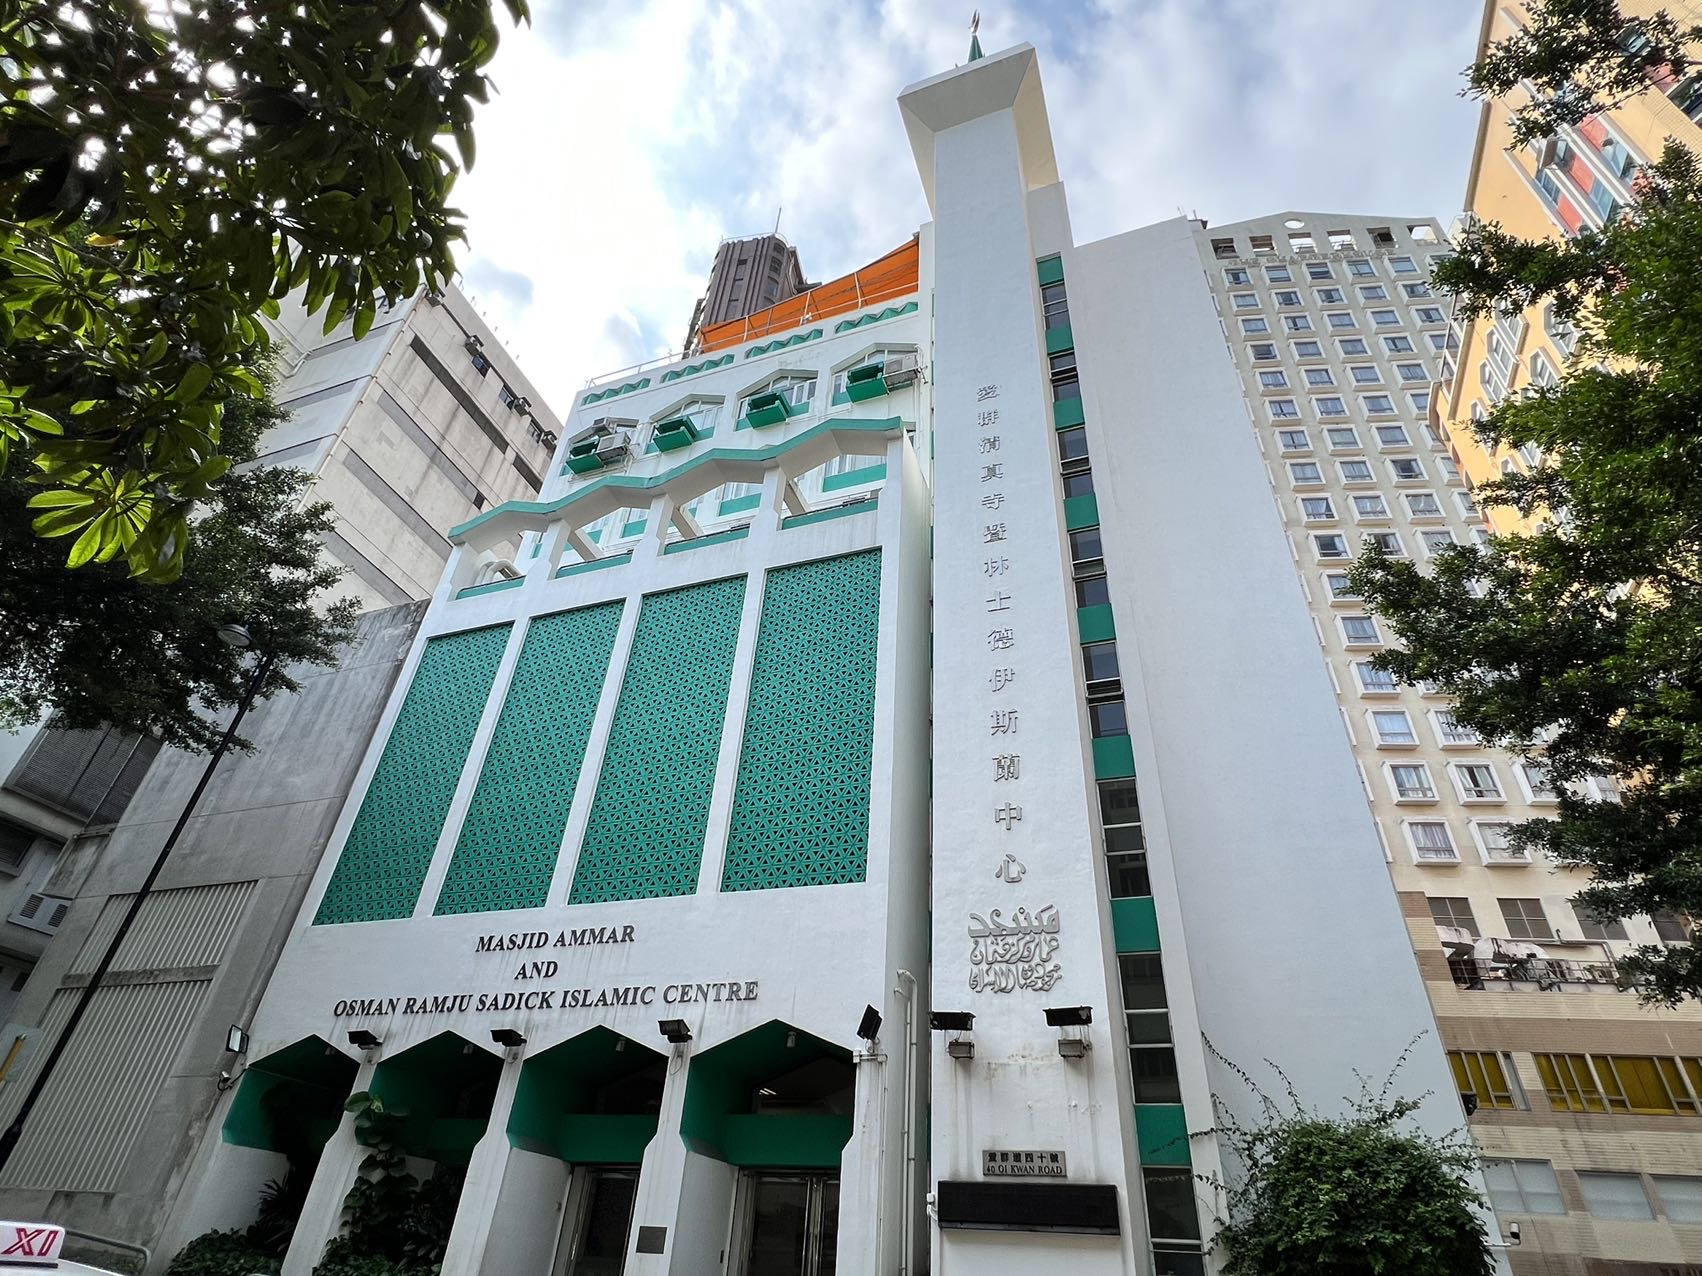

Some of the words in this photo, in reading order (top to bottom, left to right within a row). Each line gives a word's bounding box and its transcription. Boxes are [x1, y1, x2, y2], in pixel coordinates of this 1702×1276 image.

[475, 931, 549, 952] MASJID
[553, 925, 635, 948] AMMAR
[514, 960, 559, 980] AND
[333, 997, 399, 1017] OSMAN
[402, 994, 474, 1015] RAMJU
[476, 990, 555, 1011] SADICK
[559, 984, 656, 1008] ISLAMIC
[663, 981, 759, 1004] CENTRE
[998, 1165, 1008, 1173] OI
[1010, 1165, 1035, 1174] KWAN
[1038, 1165, 1062, 1174] ROAD
